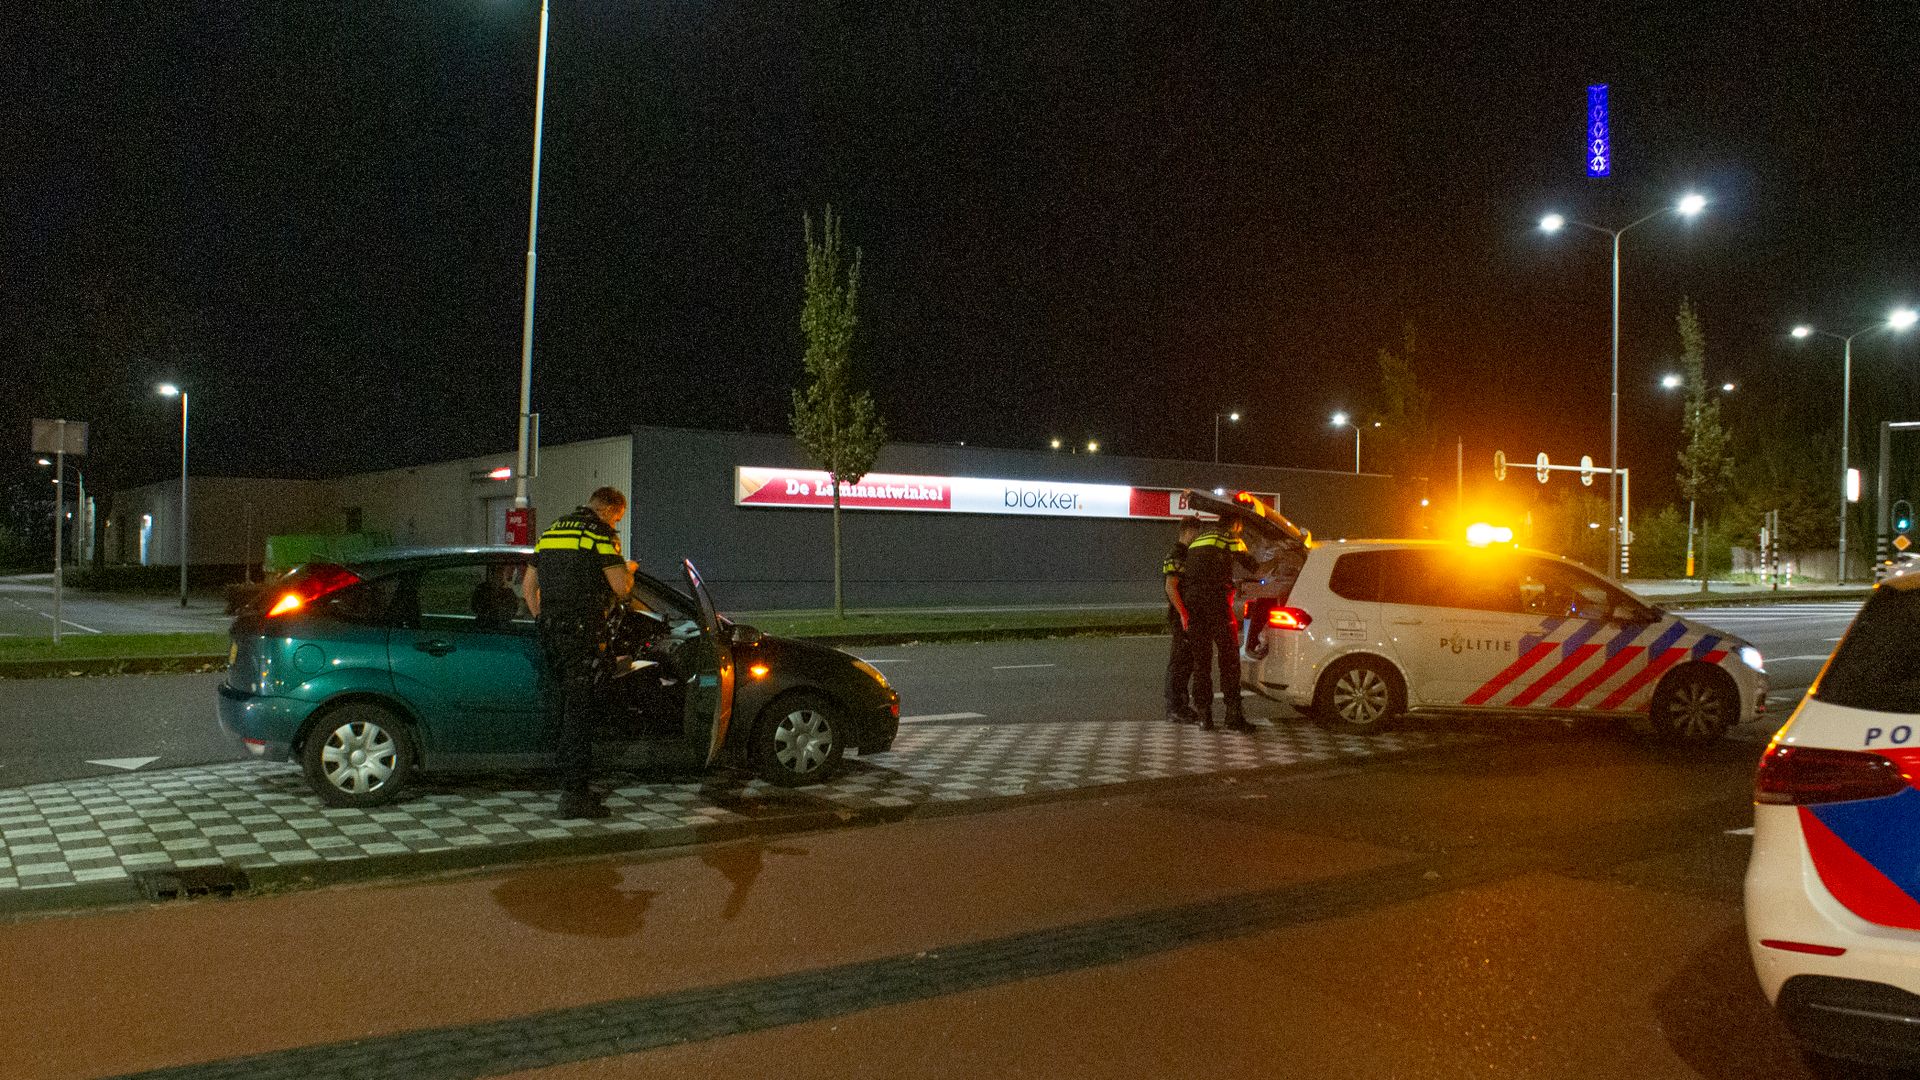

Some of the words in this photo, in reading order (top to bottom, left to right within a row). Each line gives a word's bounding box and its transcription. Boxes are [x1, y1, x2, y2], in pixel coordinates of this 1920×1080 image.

[786, 478, 810, 496] De
[1440, 637, 1511, 655] POLITIE
[1864, 725, 1913, 746] PO
